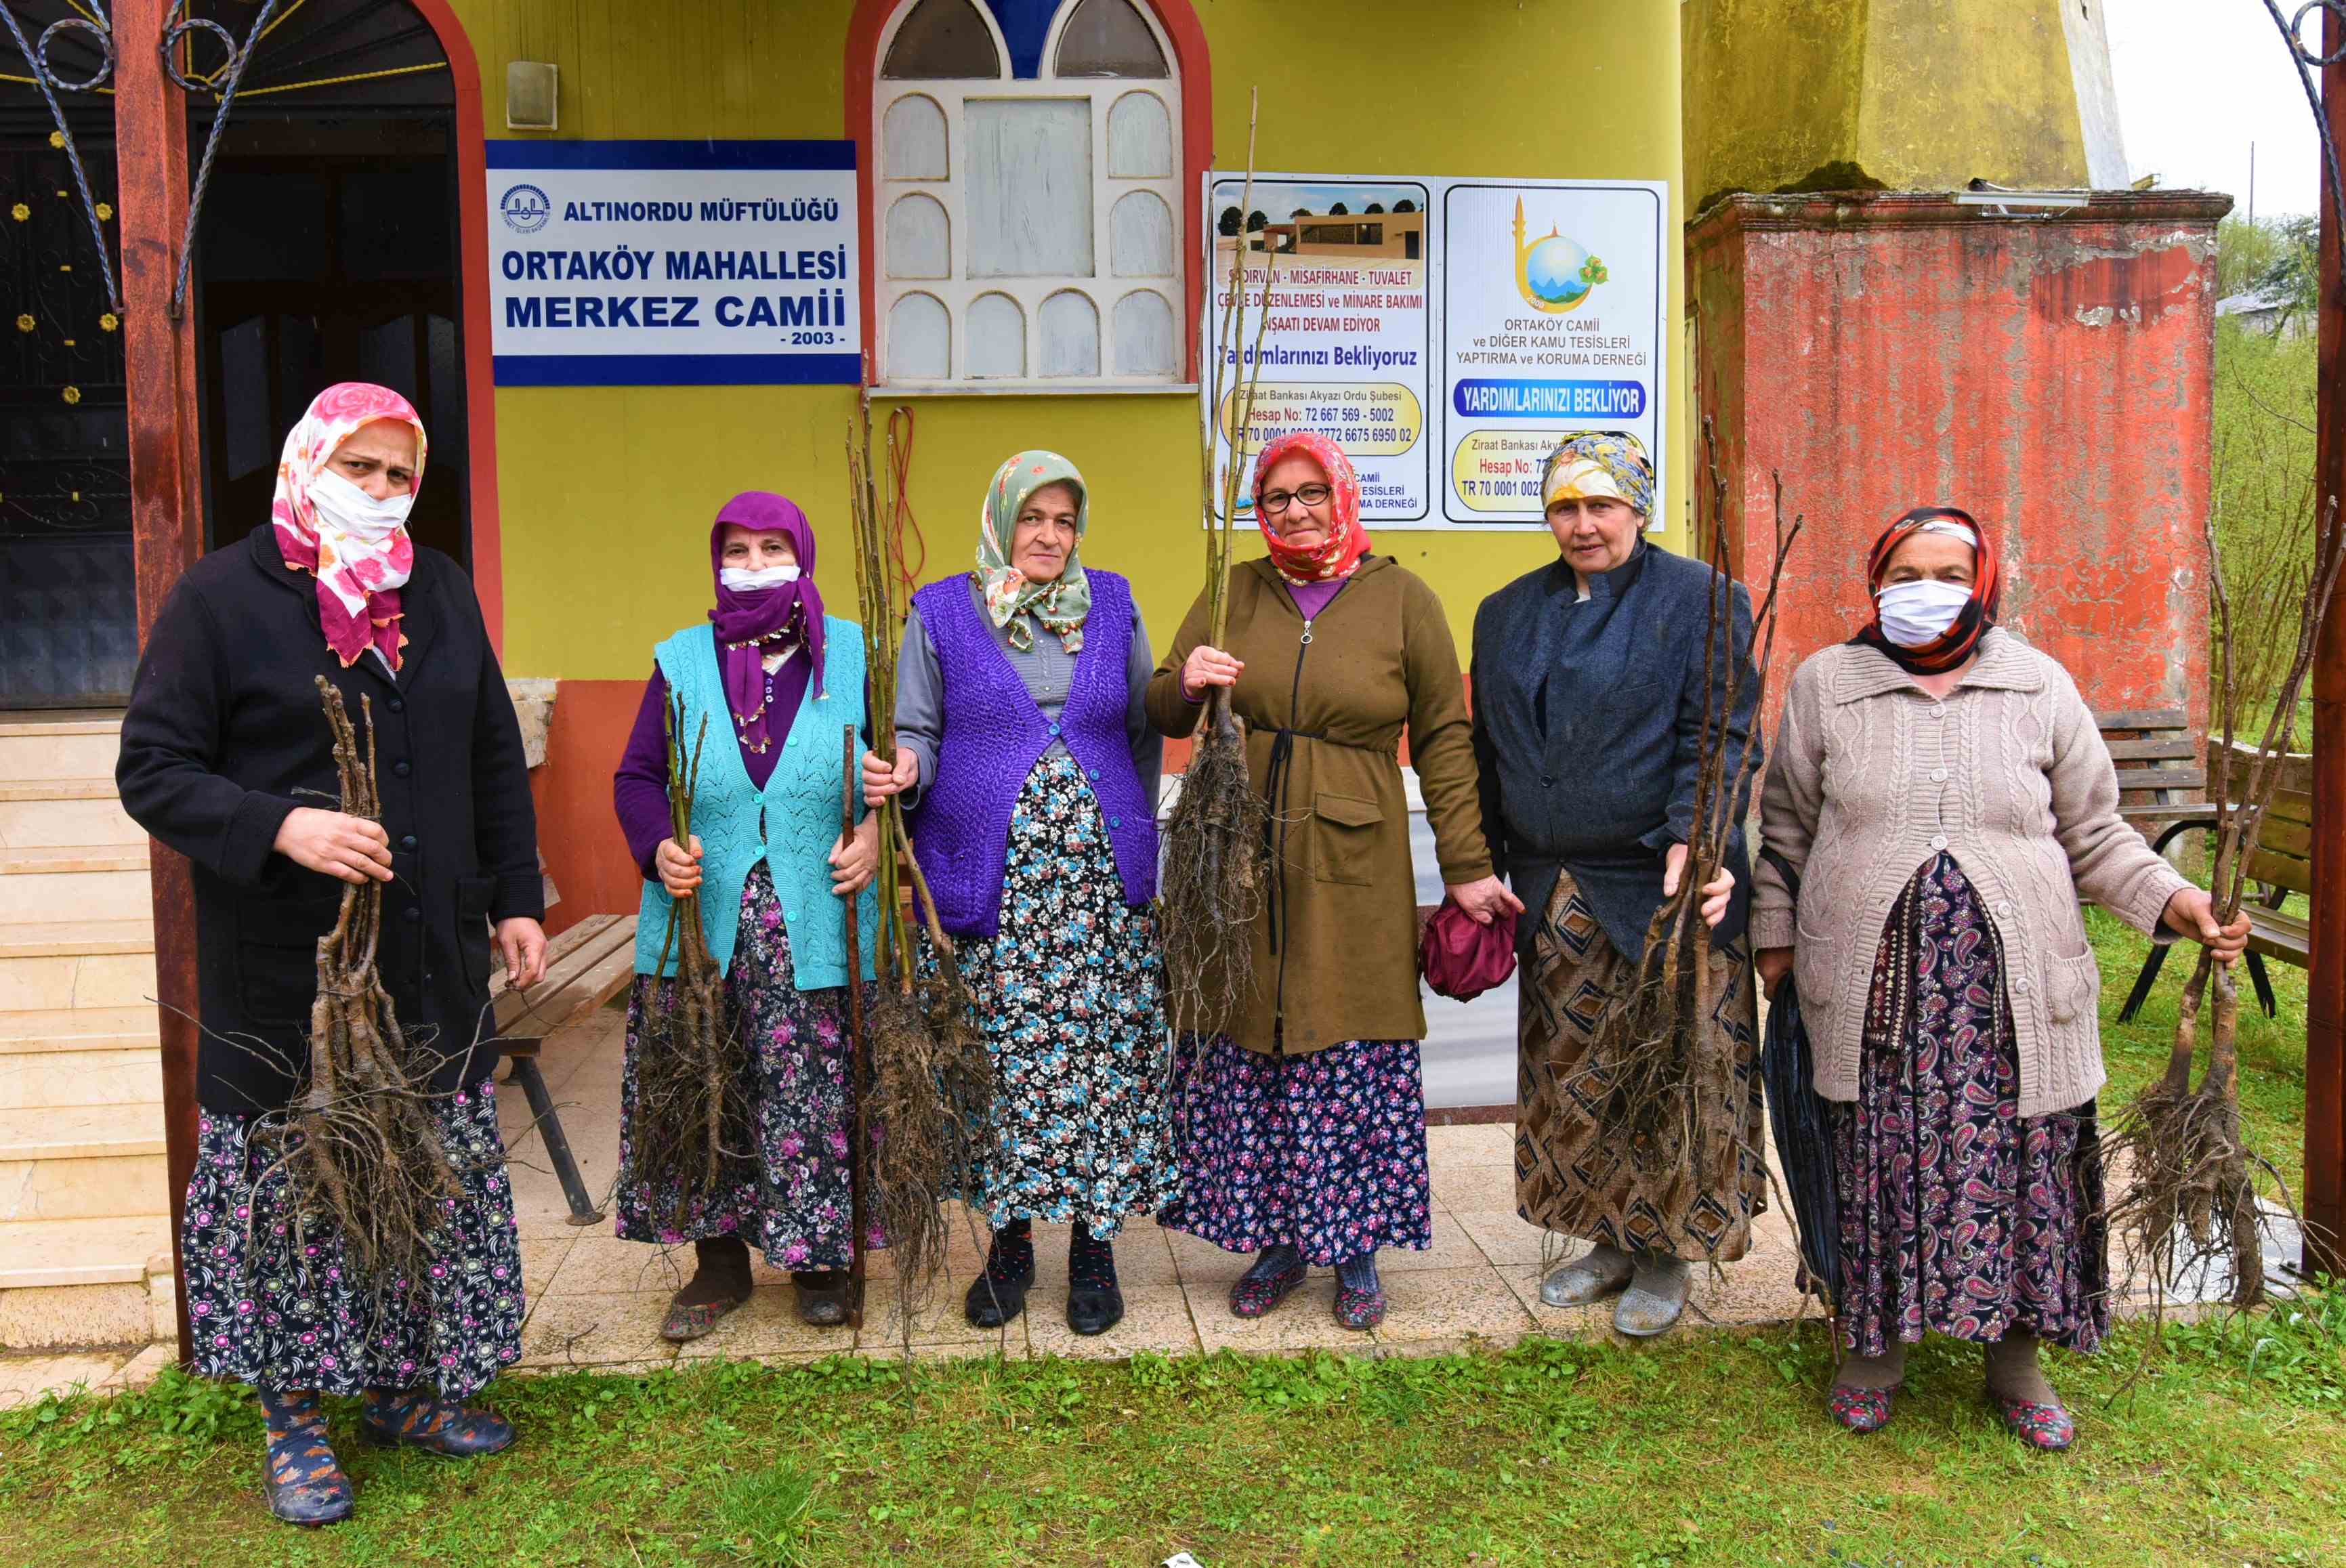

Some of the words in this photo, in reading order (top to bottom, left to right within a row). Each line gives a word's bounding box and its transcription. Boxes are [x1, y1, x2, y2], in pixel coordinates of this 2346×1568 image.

[564, 201, 692, 221] ALTINORDU
[700, 196, 839, 221] MÜFTÜLÜĞÜ
[501, 245, 655, 280] ORTAKÖY
[665, 244, 846, 280] MAHALLESİ
[1290, 266, 1359, 284] MİSAFİRHANE
[1368, 271, 1412, 285] TUVALET
[505, 297, 700, 327] MERKEZ
[715, 288, 845, 327] CAMİİ
[1218, 293, 1250, 311] ÇEVE
[1328, 296, 1339, 308] ve
[1343, 290, 1383, 309] MİNARE
[1386, 294, 1422, 309] BAKIMI
[1265, 316, 1299, 335] NŞAATI
[1303, 317, 1340, 331] DEVAM
[1343, 314, 1381, 332] EDİYOR
[1505, 317, 1562, 331] ORTAKÖY
[1566, 318, 1599, 332] CAMİİ
[791, 331, 835, 345] 2003
[1473, 338, 1486, 347] ve
[1490, 333, 1527, 347] DİĞER
[1531, 336, 1566, 347] KAMU
[1570, 334, 1630, 349] TESİSLERİ
[1334, 345, 1417, 370] Bekliyoruz
[1457, 352, 1517, 364] YAPTIRMA
[1521, 355, 1533, 364] ve
[1537, 353, 1589, 365] KORUMA
[1593, 352, 1646, 366] DERNEĞİ
[1240, 390, 1266, 400] Ziaat
[1270, 390, 1307, 401] Bankası
[1310, 391, 1341, 403] Akyazı
[1344, 390, 1367, 401] Ordu
[1370, 390, 1402, 403] Şubesi
[1463, 386, 1570, 412] YARDIMLARINIZI
[1574, 381, 1639, 413] BEKLİYOR
[1284, 408, 1301, 421] No:
[1305, 408, 1317, 421] 72
[1321, 408, 1338, 421] 667
[1342, 408, 1360, 421] 569
[1370, 408, 1394, 422] 5002
[1248, 427, 1260, 441] 70
[1345, 428, 1368, 442] 6675
[1373, 428, 1396, 442] 6950
[1400, 428, 1411, 442] 02
[1471, 439, 1498, 450] Ziraat
[1501, 439, 1538, 450] Bankası
[1480, 459, 1511, 477] Hesap
[1515, 459, 1532, 473] No:
[1361, 484, 1404, 496] ESİSLERİ
[1462, 481, 1475, 495] TR
[1480, 481, 1490, 496] 70
[1494, 481, 1516, 496] 0001
[1522, 481, 1542, 496] 002
[1375, 497, 1417, 508] DERNEĞİ
